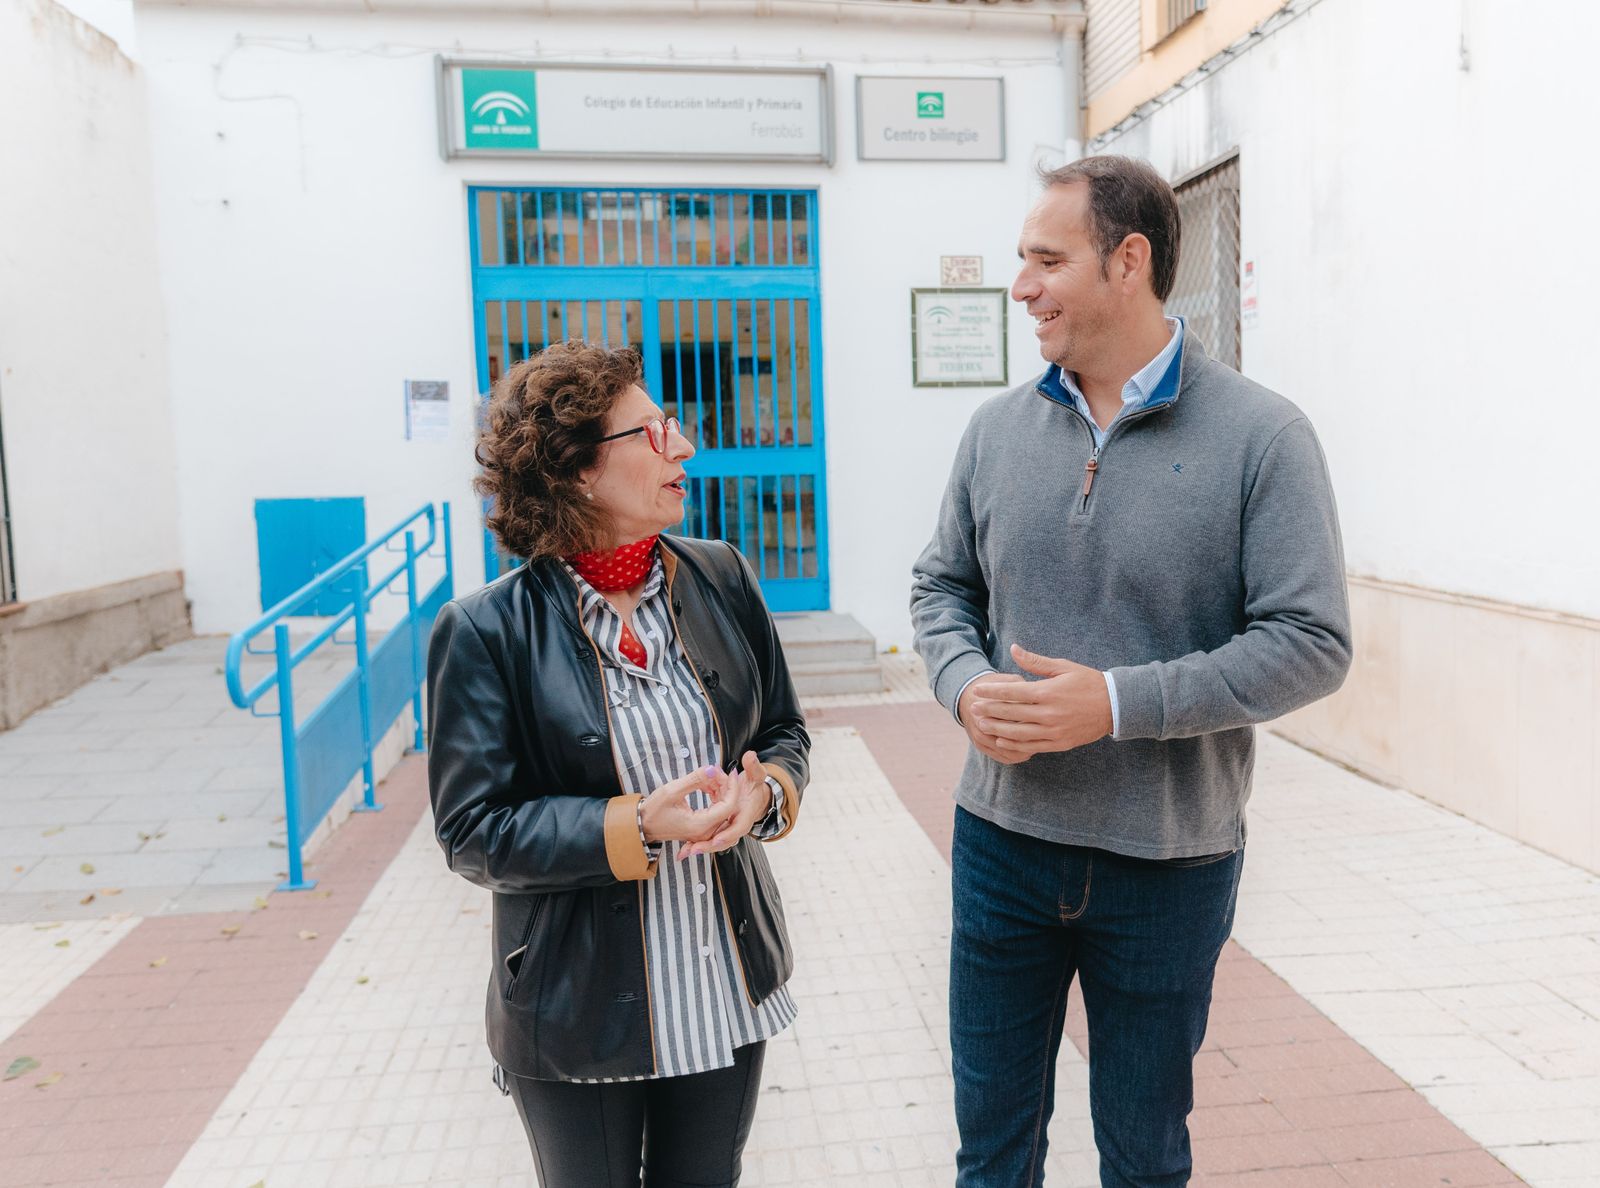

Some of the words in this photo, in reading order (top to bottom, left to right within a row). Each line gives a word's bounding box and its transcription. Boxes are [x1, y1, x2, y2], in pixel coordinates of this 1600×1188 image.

[583, 95, 626, 111] Colegio
[629, 96, 643, 109] de
[645, 96, 703, 110] Educación
[705, 97, 745, 110] Infantil
[747, 100, 754, 113] y
[756, 97, 803, 111] Primaria
[883, 127, 927, 142] Centro
[929, 127, 979, 146] bilingüe
